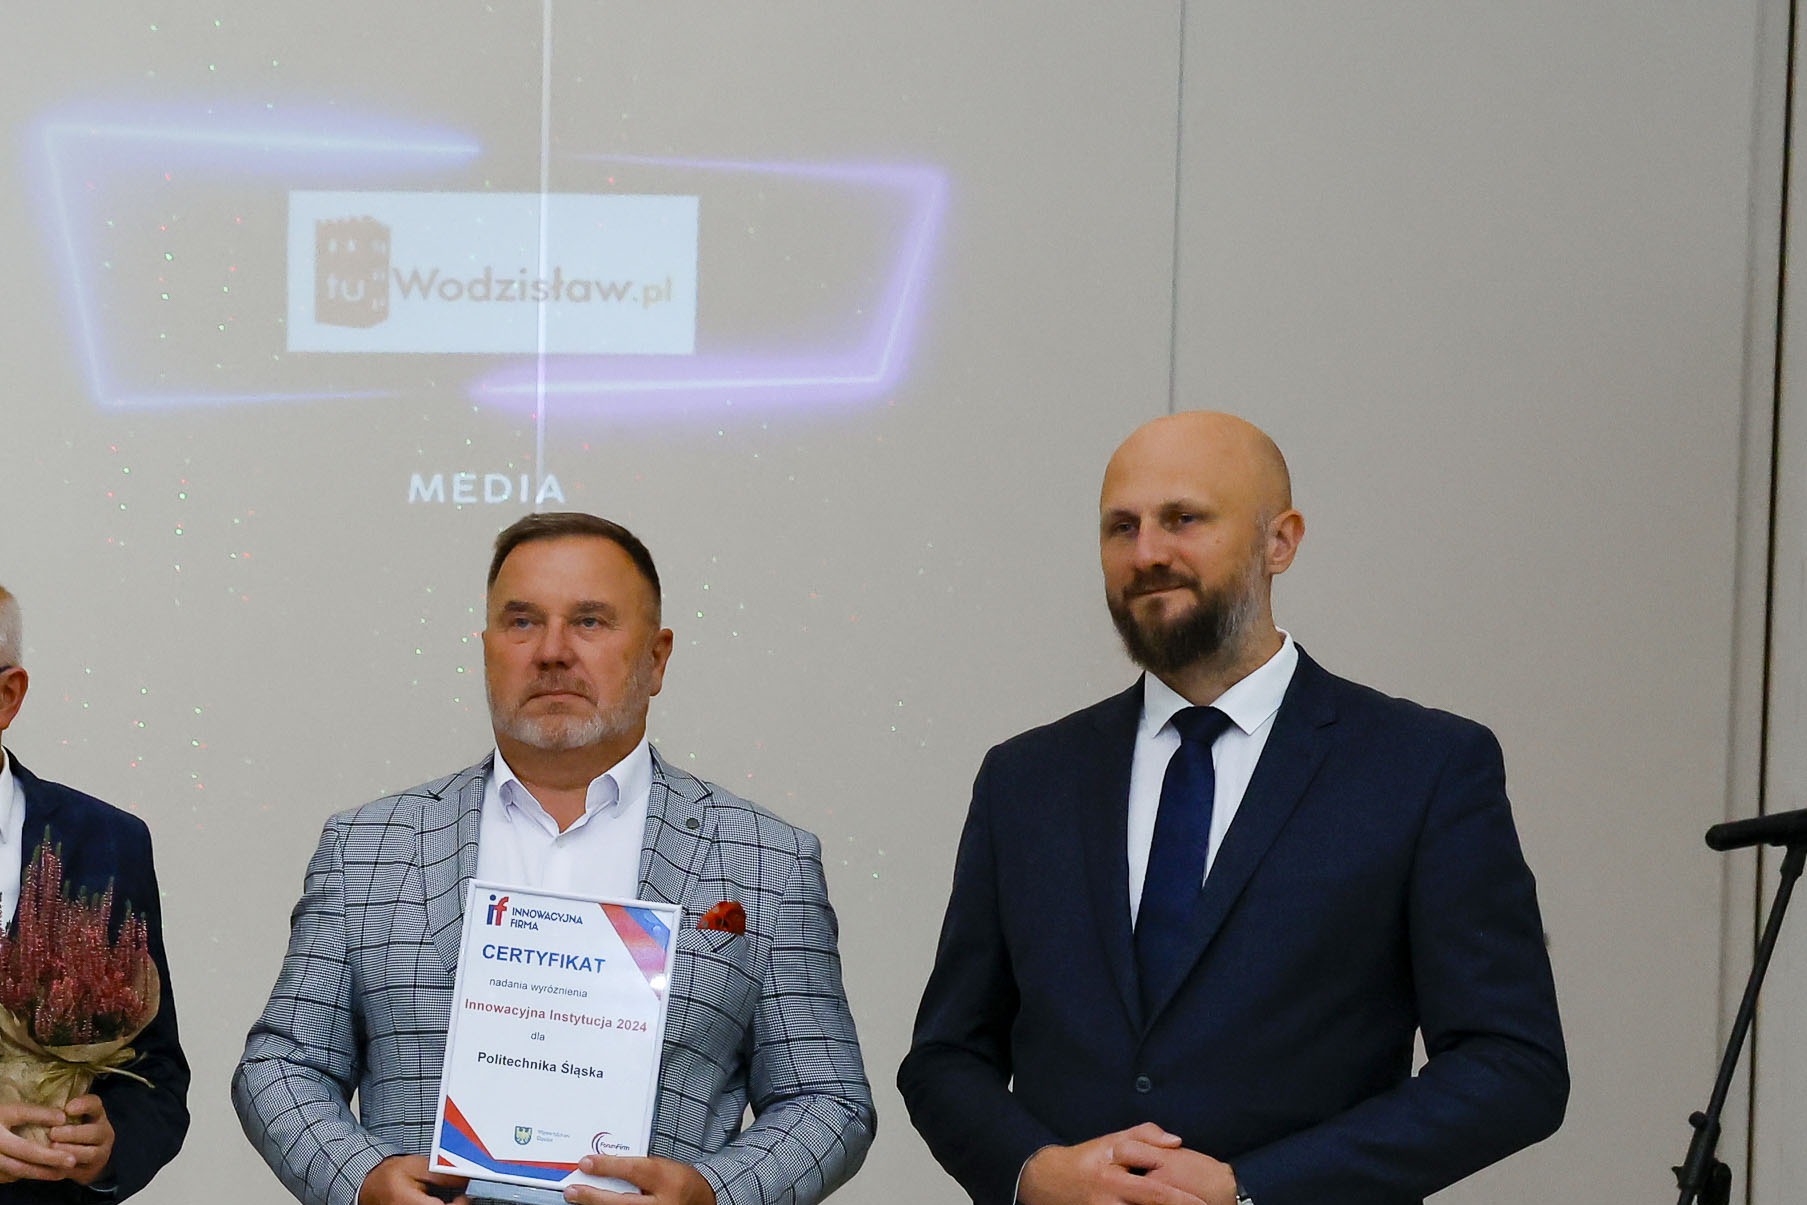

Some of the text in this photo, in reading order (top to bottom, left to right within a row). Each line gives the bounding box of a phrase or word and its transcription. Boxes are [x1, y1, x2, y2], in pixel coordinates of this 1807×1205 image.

[391, 265, 673, 309] Wodzisław.pl
[407, 472, 566, 505] MEDIA
[510, 919, 539, 931] FIRMA
[511, 907, 584, 925] INNOWACYJNA
[482, 944, 606, 974] CERTYFIKAT
[489, 978, 528, 990] nadania
[465, 999, 648, 1033] Innowacyjna Instytucja 2024
[530, 1031, 546, 1042] dla
[477, 1051, 604, 1079] Politechnika Śląska
